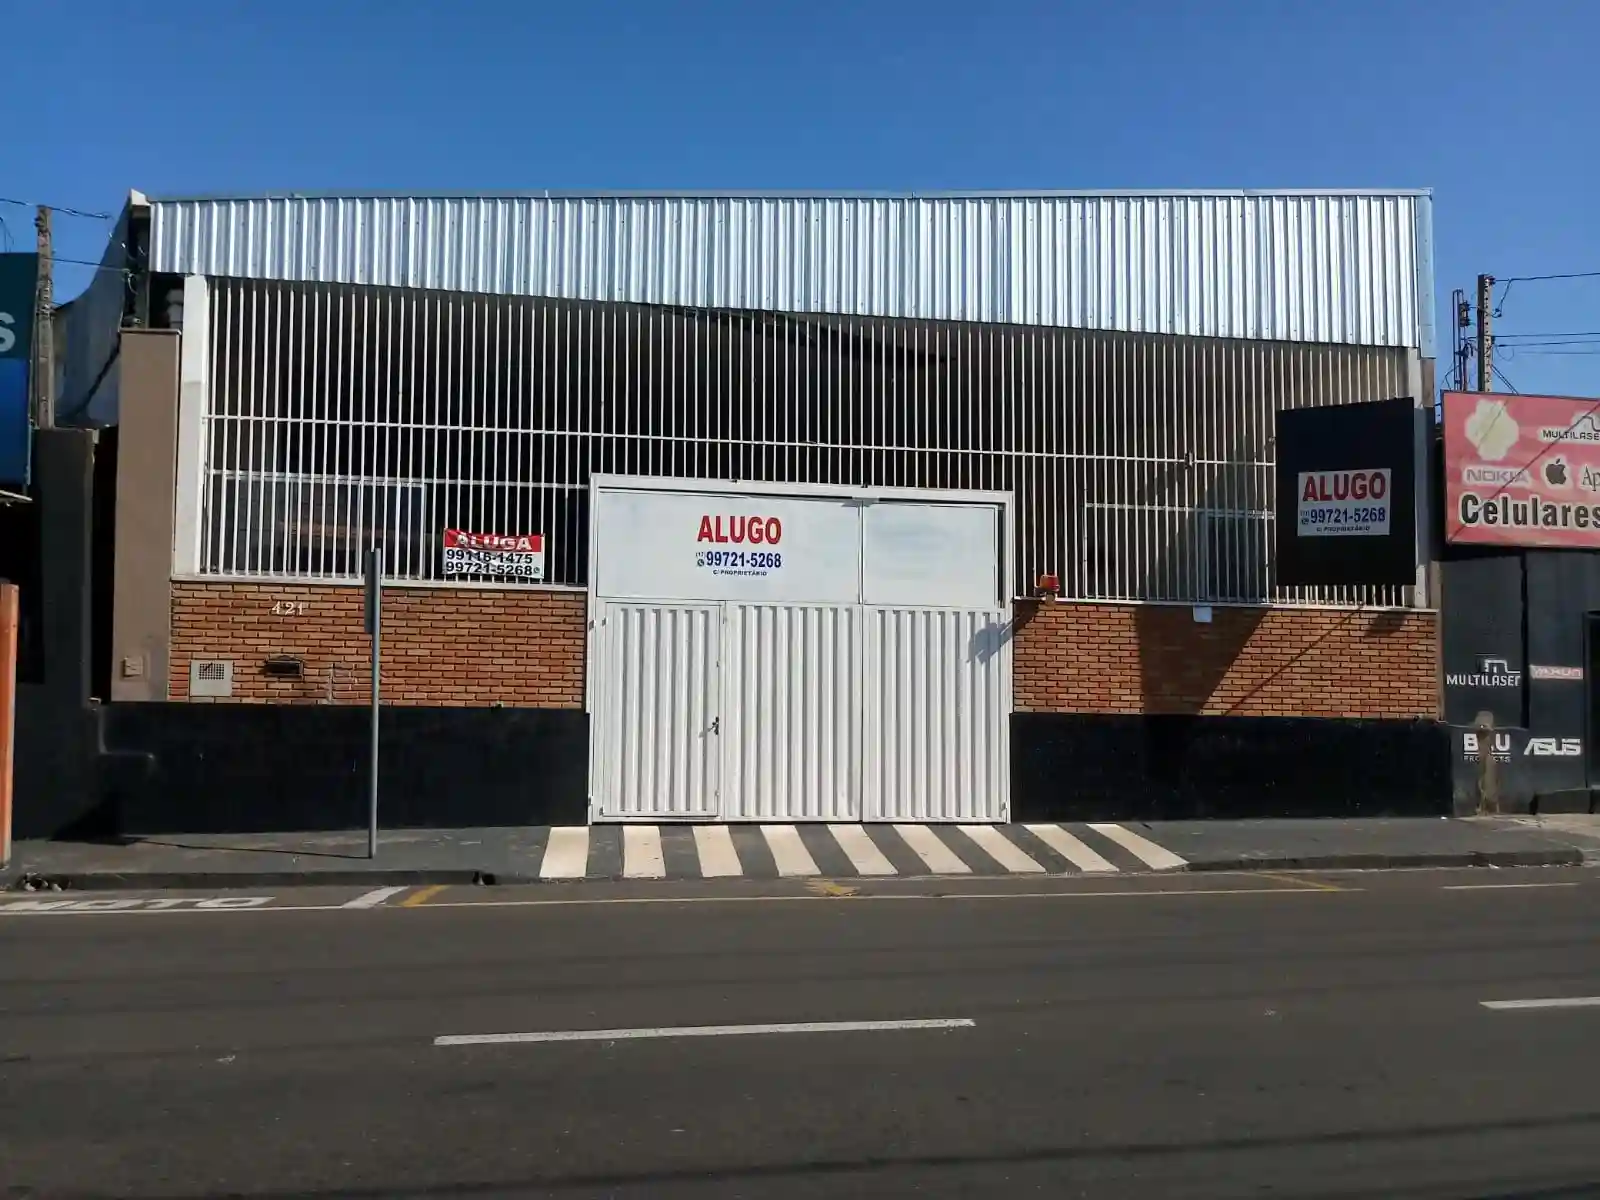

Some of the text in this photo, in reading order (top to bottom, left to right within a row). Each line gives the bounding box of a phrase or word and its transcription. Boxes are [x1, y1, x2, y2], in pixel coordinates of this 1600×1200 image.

[1466, 469, 1528, 482] NOKIA
[1303, 472, 1386, 501] ALUGO
[1310, 507, 1386, 524] 99721-5268
[1461, 494, 1600, 528] Celulares
[697, 515, 782, 544] ALUGO
[706, 551, 782, 568] 99721-5268
[446, 561, 533, 576] 99721-5268
[271, 600, 304, 615] 421
[1463, 733, 1510, 751] BU
[1523, 738, 1581, 755] ASUS
